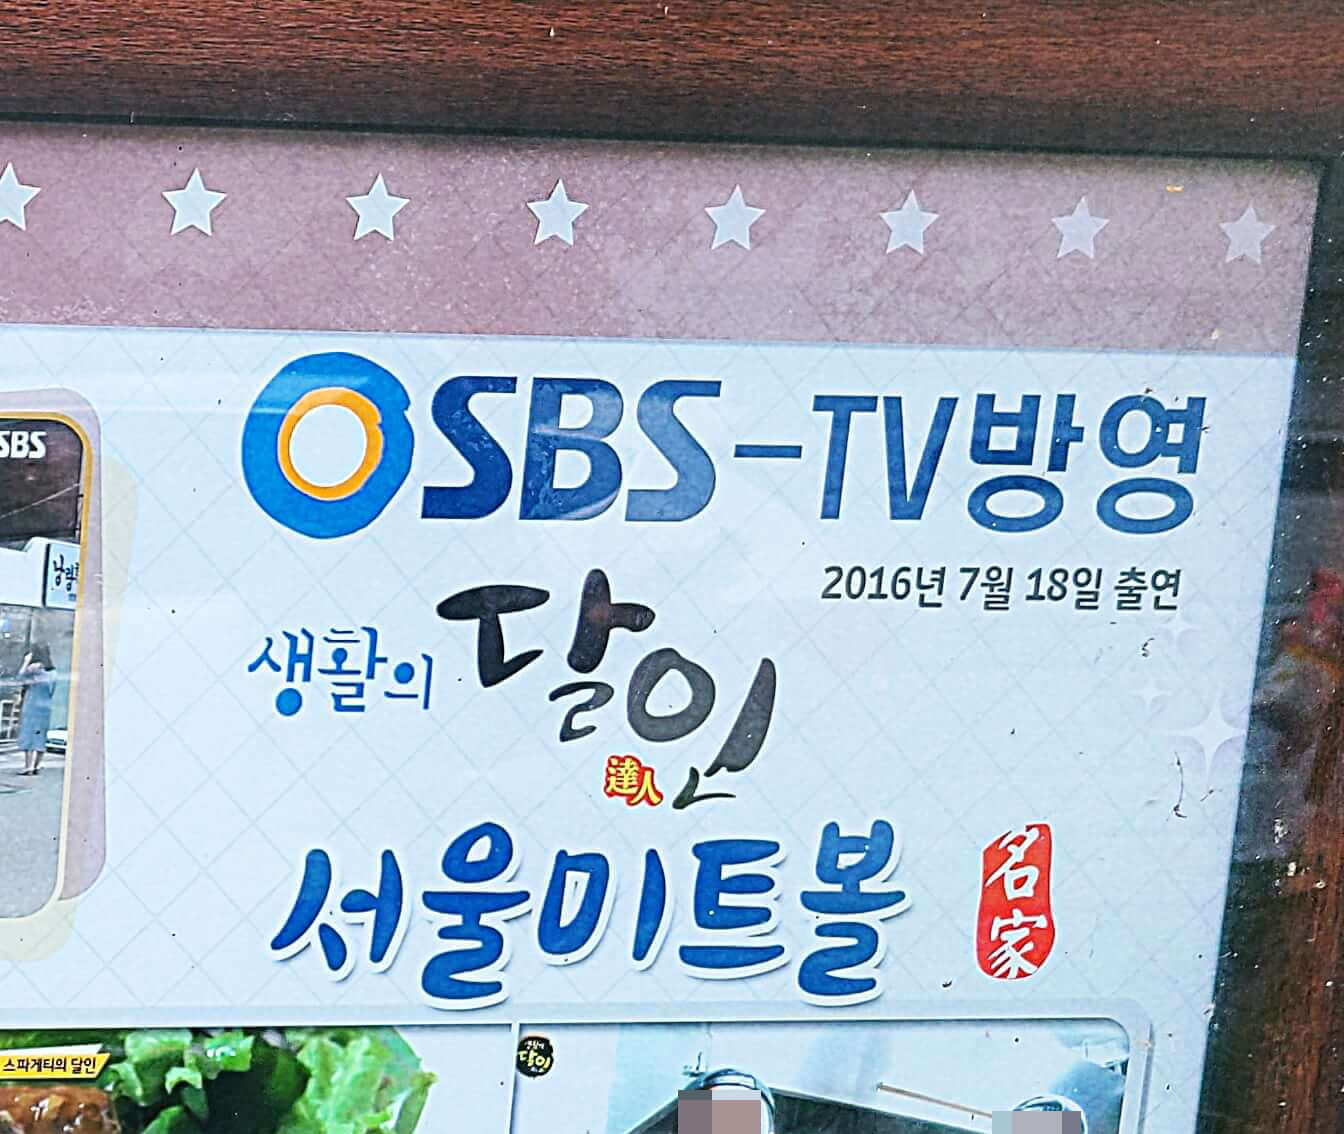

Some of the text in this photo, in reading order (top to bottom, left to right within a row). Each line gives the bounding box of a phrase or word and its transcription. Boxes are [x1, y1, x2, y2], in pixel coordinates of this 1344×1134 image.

[821, 566, 1181, 611] 2016년 7월 18일 출연
[248, 568, 777, 810] 생활의 달인
[604, 756, 663, 806] 達人
[268, 818, 910, 1006] 서울미트볼
[984, 826, 1048, 980] 名家
[3, 1056, 68, 1074] 스파게티의
[71, 1055, 97, 1074] 달인
